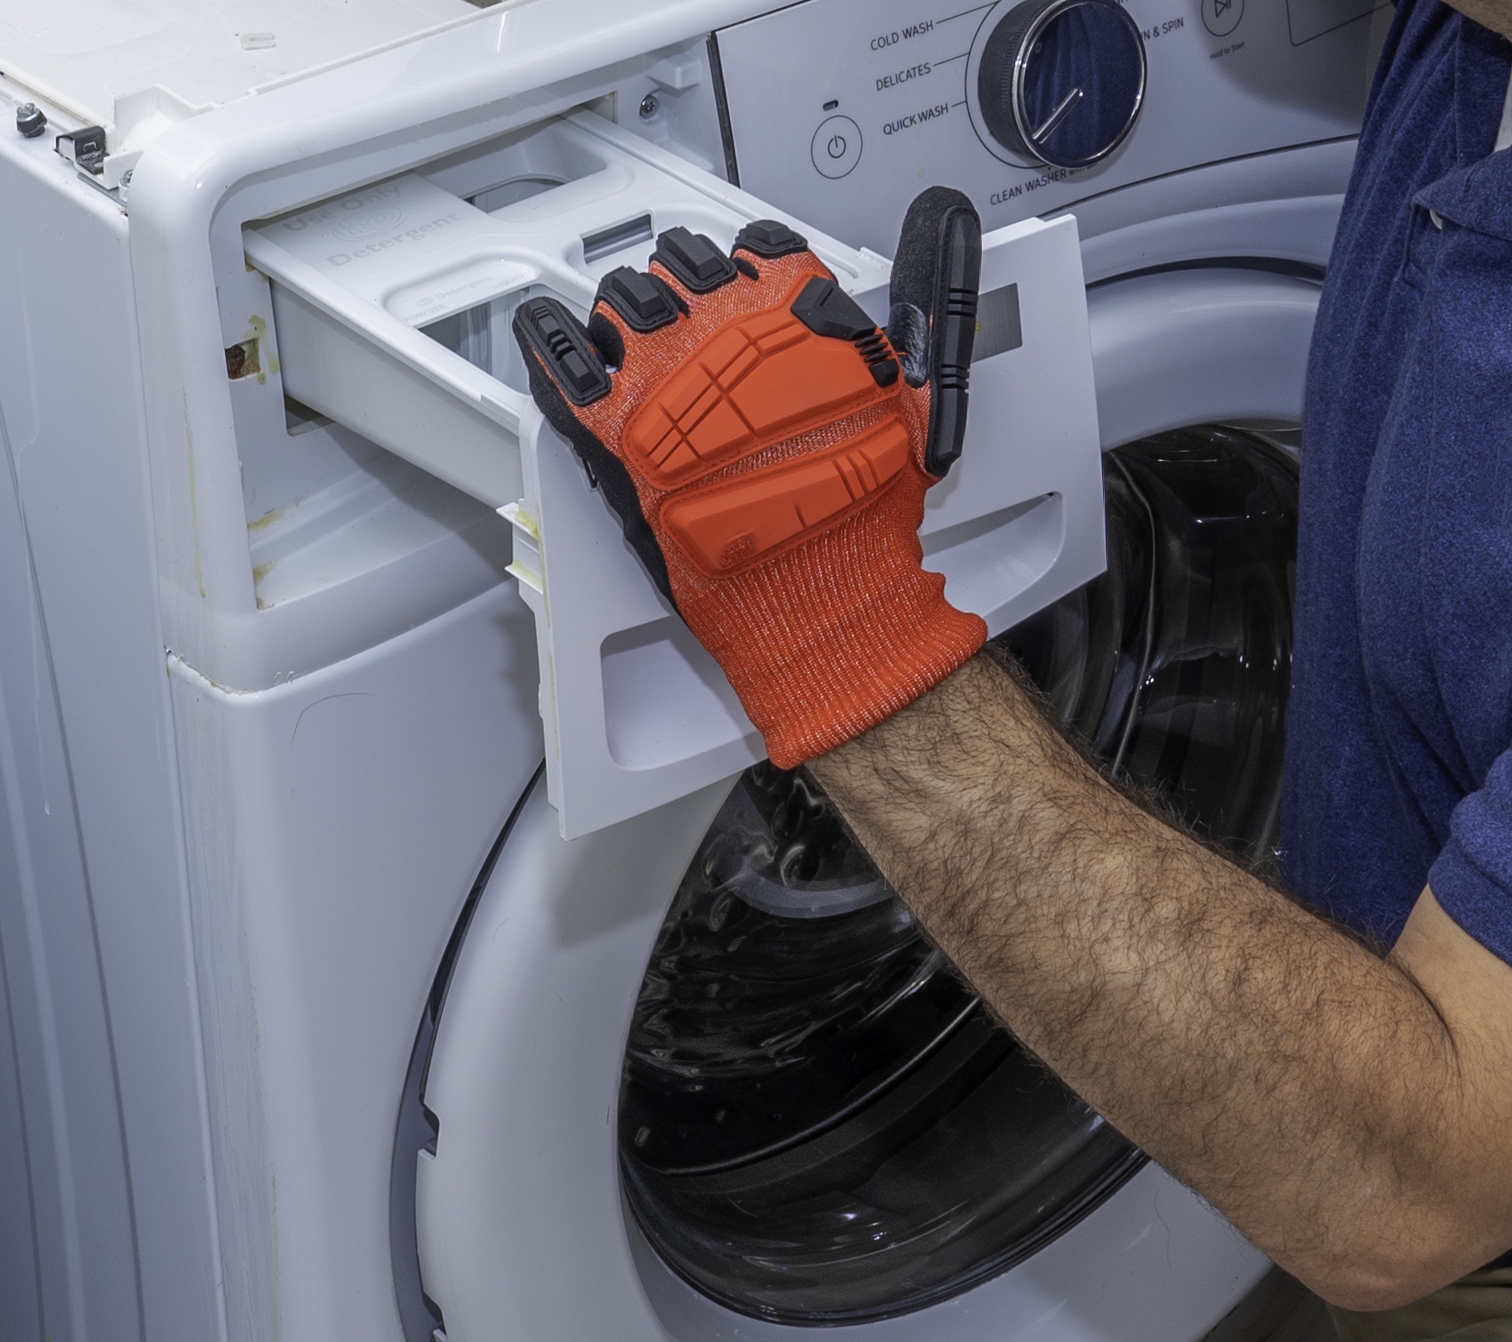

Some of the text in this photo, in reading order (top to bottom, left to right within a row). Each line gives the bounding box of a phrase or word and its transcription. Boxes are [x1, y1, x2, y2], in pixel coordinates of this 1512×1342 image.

[870, 19, 935, 51] COLD WASH
[1153, 25, 1161, 37] &
[1162, 17, 1184, 35] SPIN
[875, 61, 932, 92] DELICATES
[882, 102, 950, 135] QUICK WASH
[989, 184, 1023, 206] CLEAN
[1024, 168, 1067, 192] WASHER
[281, 182, 403, 235] Use Only
[325, 209, 465, 268] Detergent
